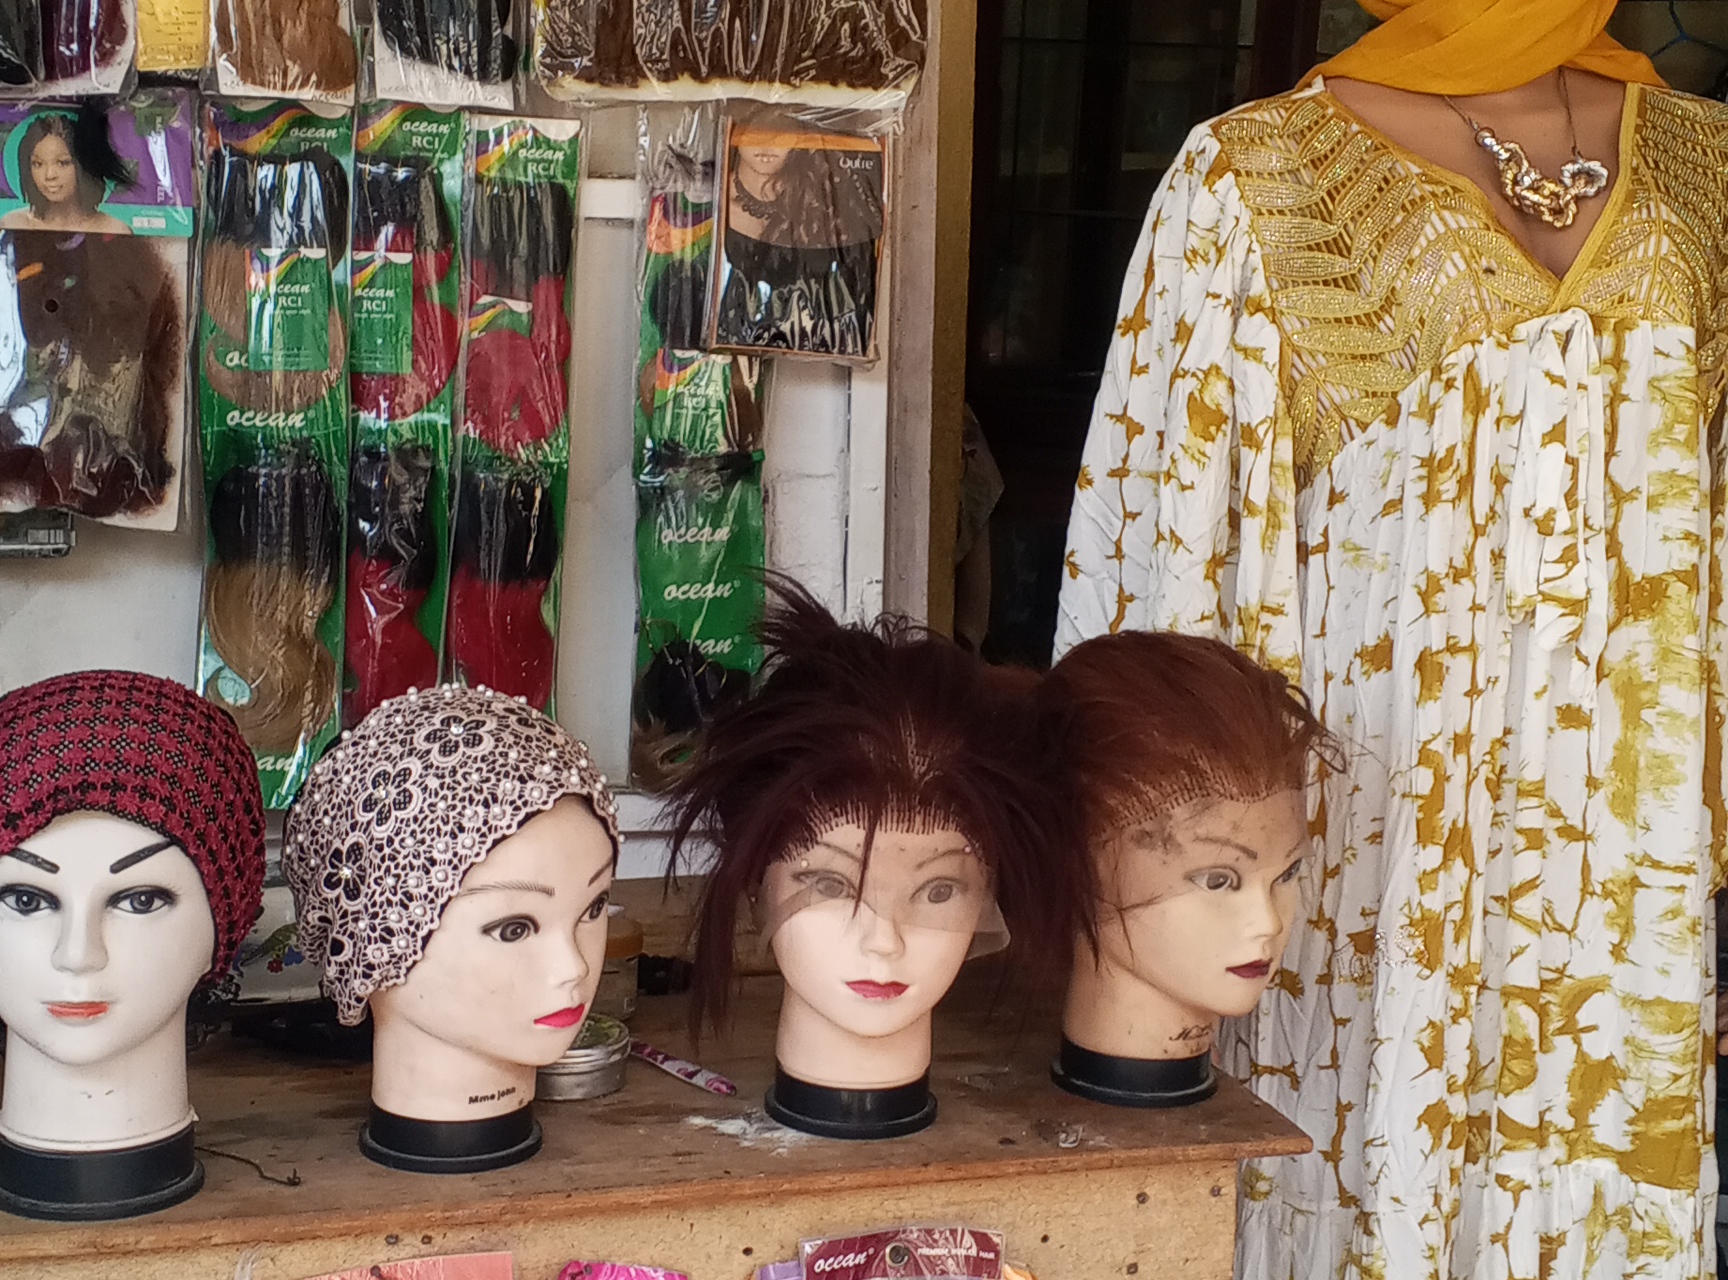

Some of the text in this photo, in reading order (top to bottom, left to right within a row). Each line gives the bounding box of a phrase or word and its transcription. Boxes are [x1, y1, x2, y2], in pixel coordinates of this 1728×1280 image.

[290, 126, 338, 140] ocean
[402, 120, 450, 134] ocean
[412, 135, 439, 150] RCI
[518, 147, 565, 160] ocean
[527, 163, 555, 176] RCI
[272, 283, 311, 294] cean
[354, 286, 395, 298] ocean
[278, 296, 303, 307] RCI
[362, 300, 386, 312] RCI
[226, 409, 306, 428] ocean
[661, 525, 731, 544] ocean
